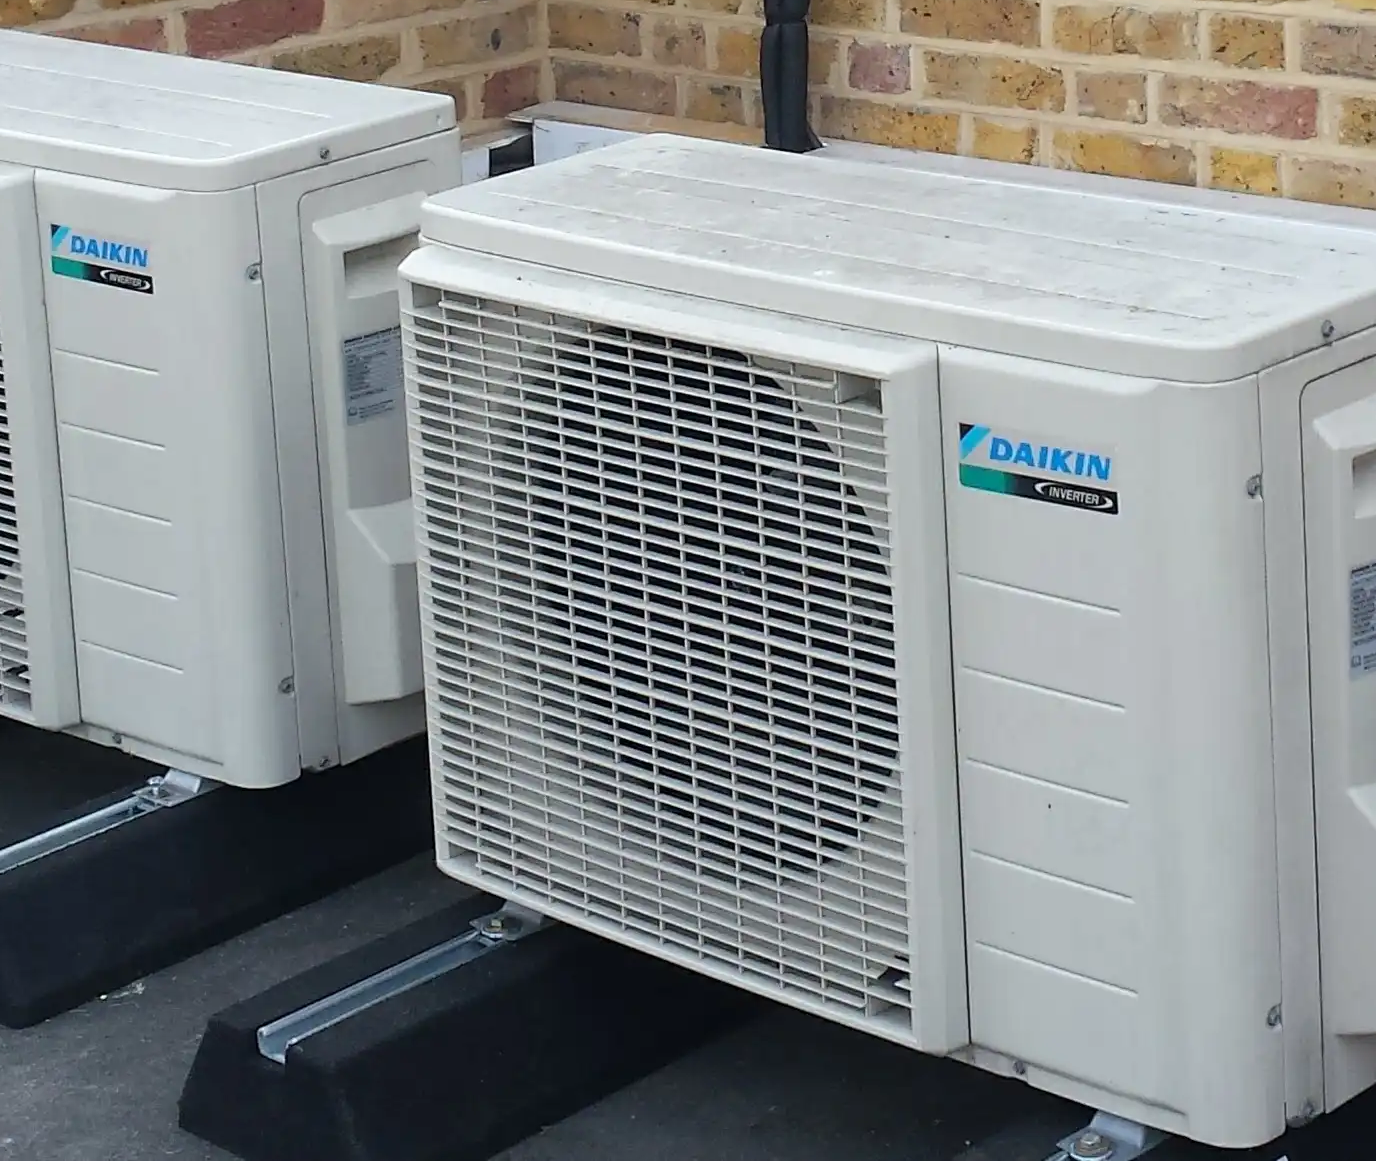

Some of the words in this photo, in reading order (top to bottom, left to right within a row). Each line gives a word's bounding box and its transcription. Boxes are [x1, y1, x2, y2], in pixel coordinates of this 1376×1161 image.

[70, 235, 149, 268] DAIKIN
[989, 436, 1111, 481] DAIKIN
[1048, 486, 1100, 505] INVERTER
